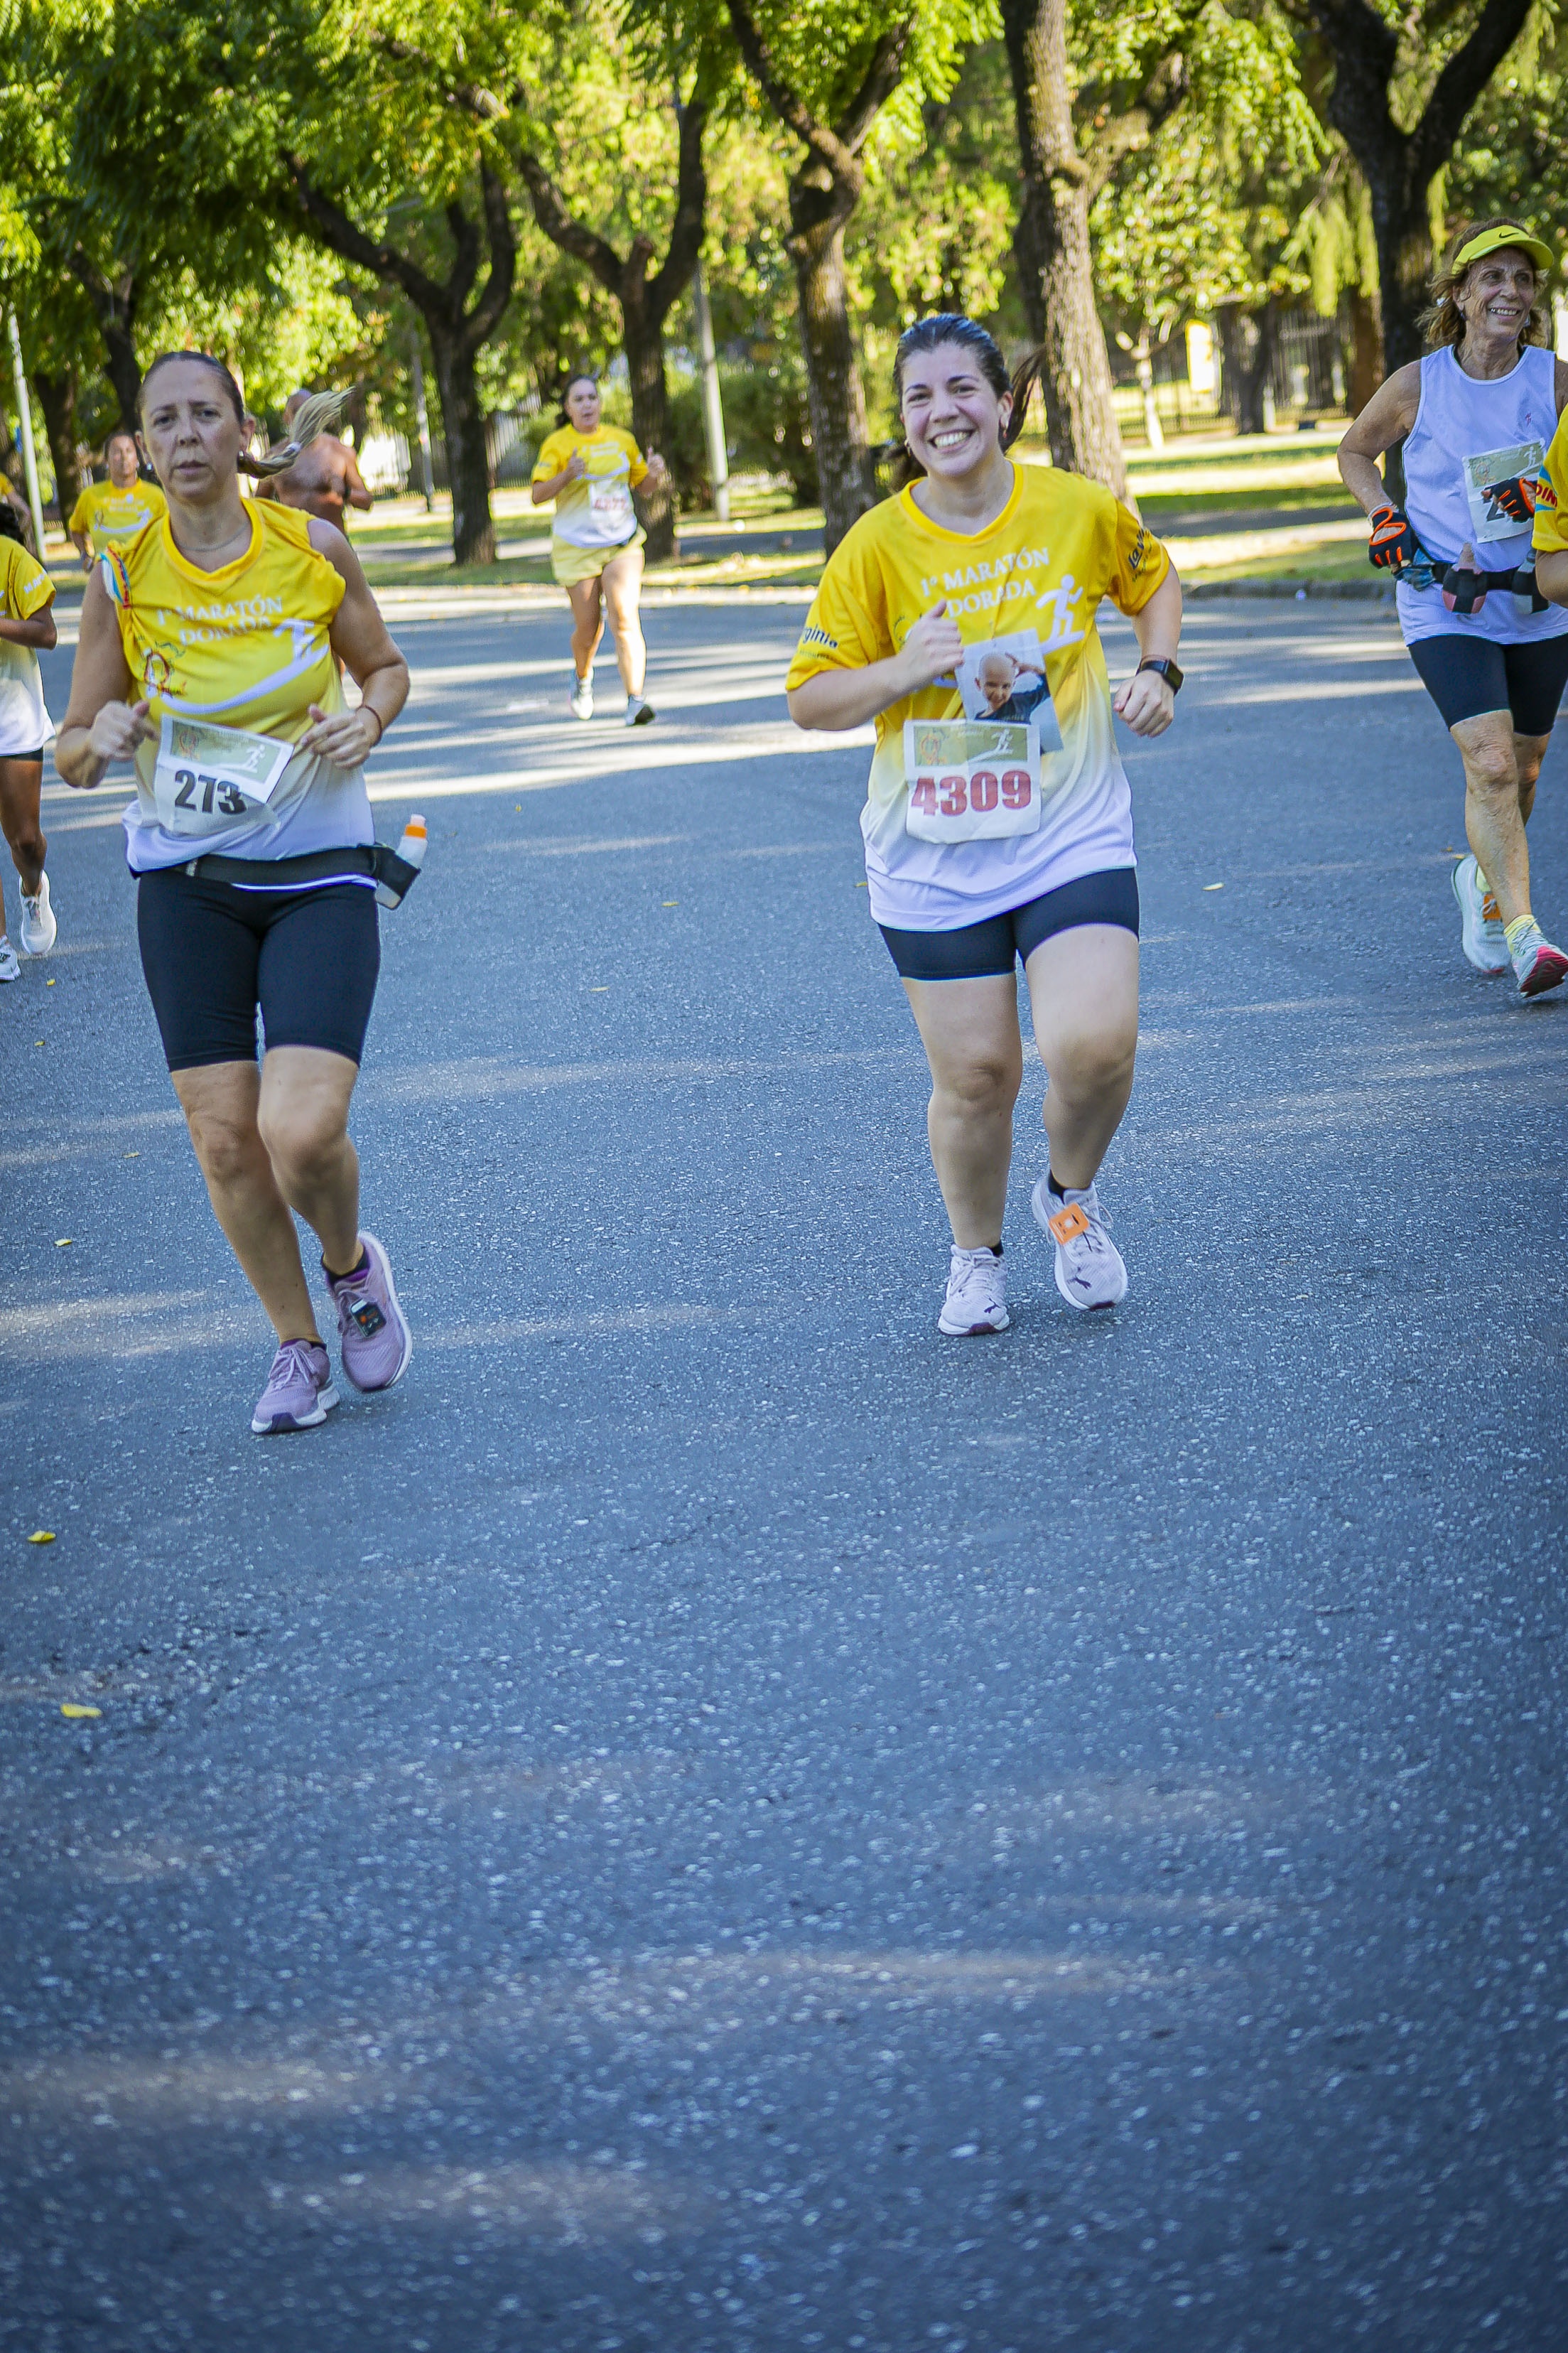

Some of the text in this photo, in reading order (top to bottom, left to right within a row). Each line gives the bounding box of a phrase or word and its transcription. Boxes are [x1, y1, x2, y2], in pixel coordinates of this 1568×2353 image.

[943, 546, 1049, 591] MARATÓN
[175, 593, 283, 621] MARATÓN
[946, 578, 1037, 618] DORADA
[179, 615, 272, 646] DORADA
[175, 769, 247, 815] 273
[911, 769, 1032, 817] 4309
